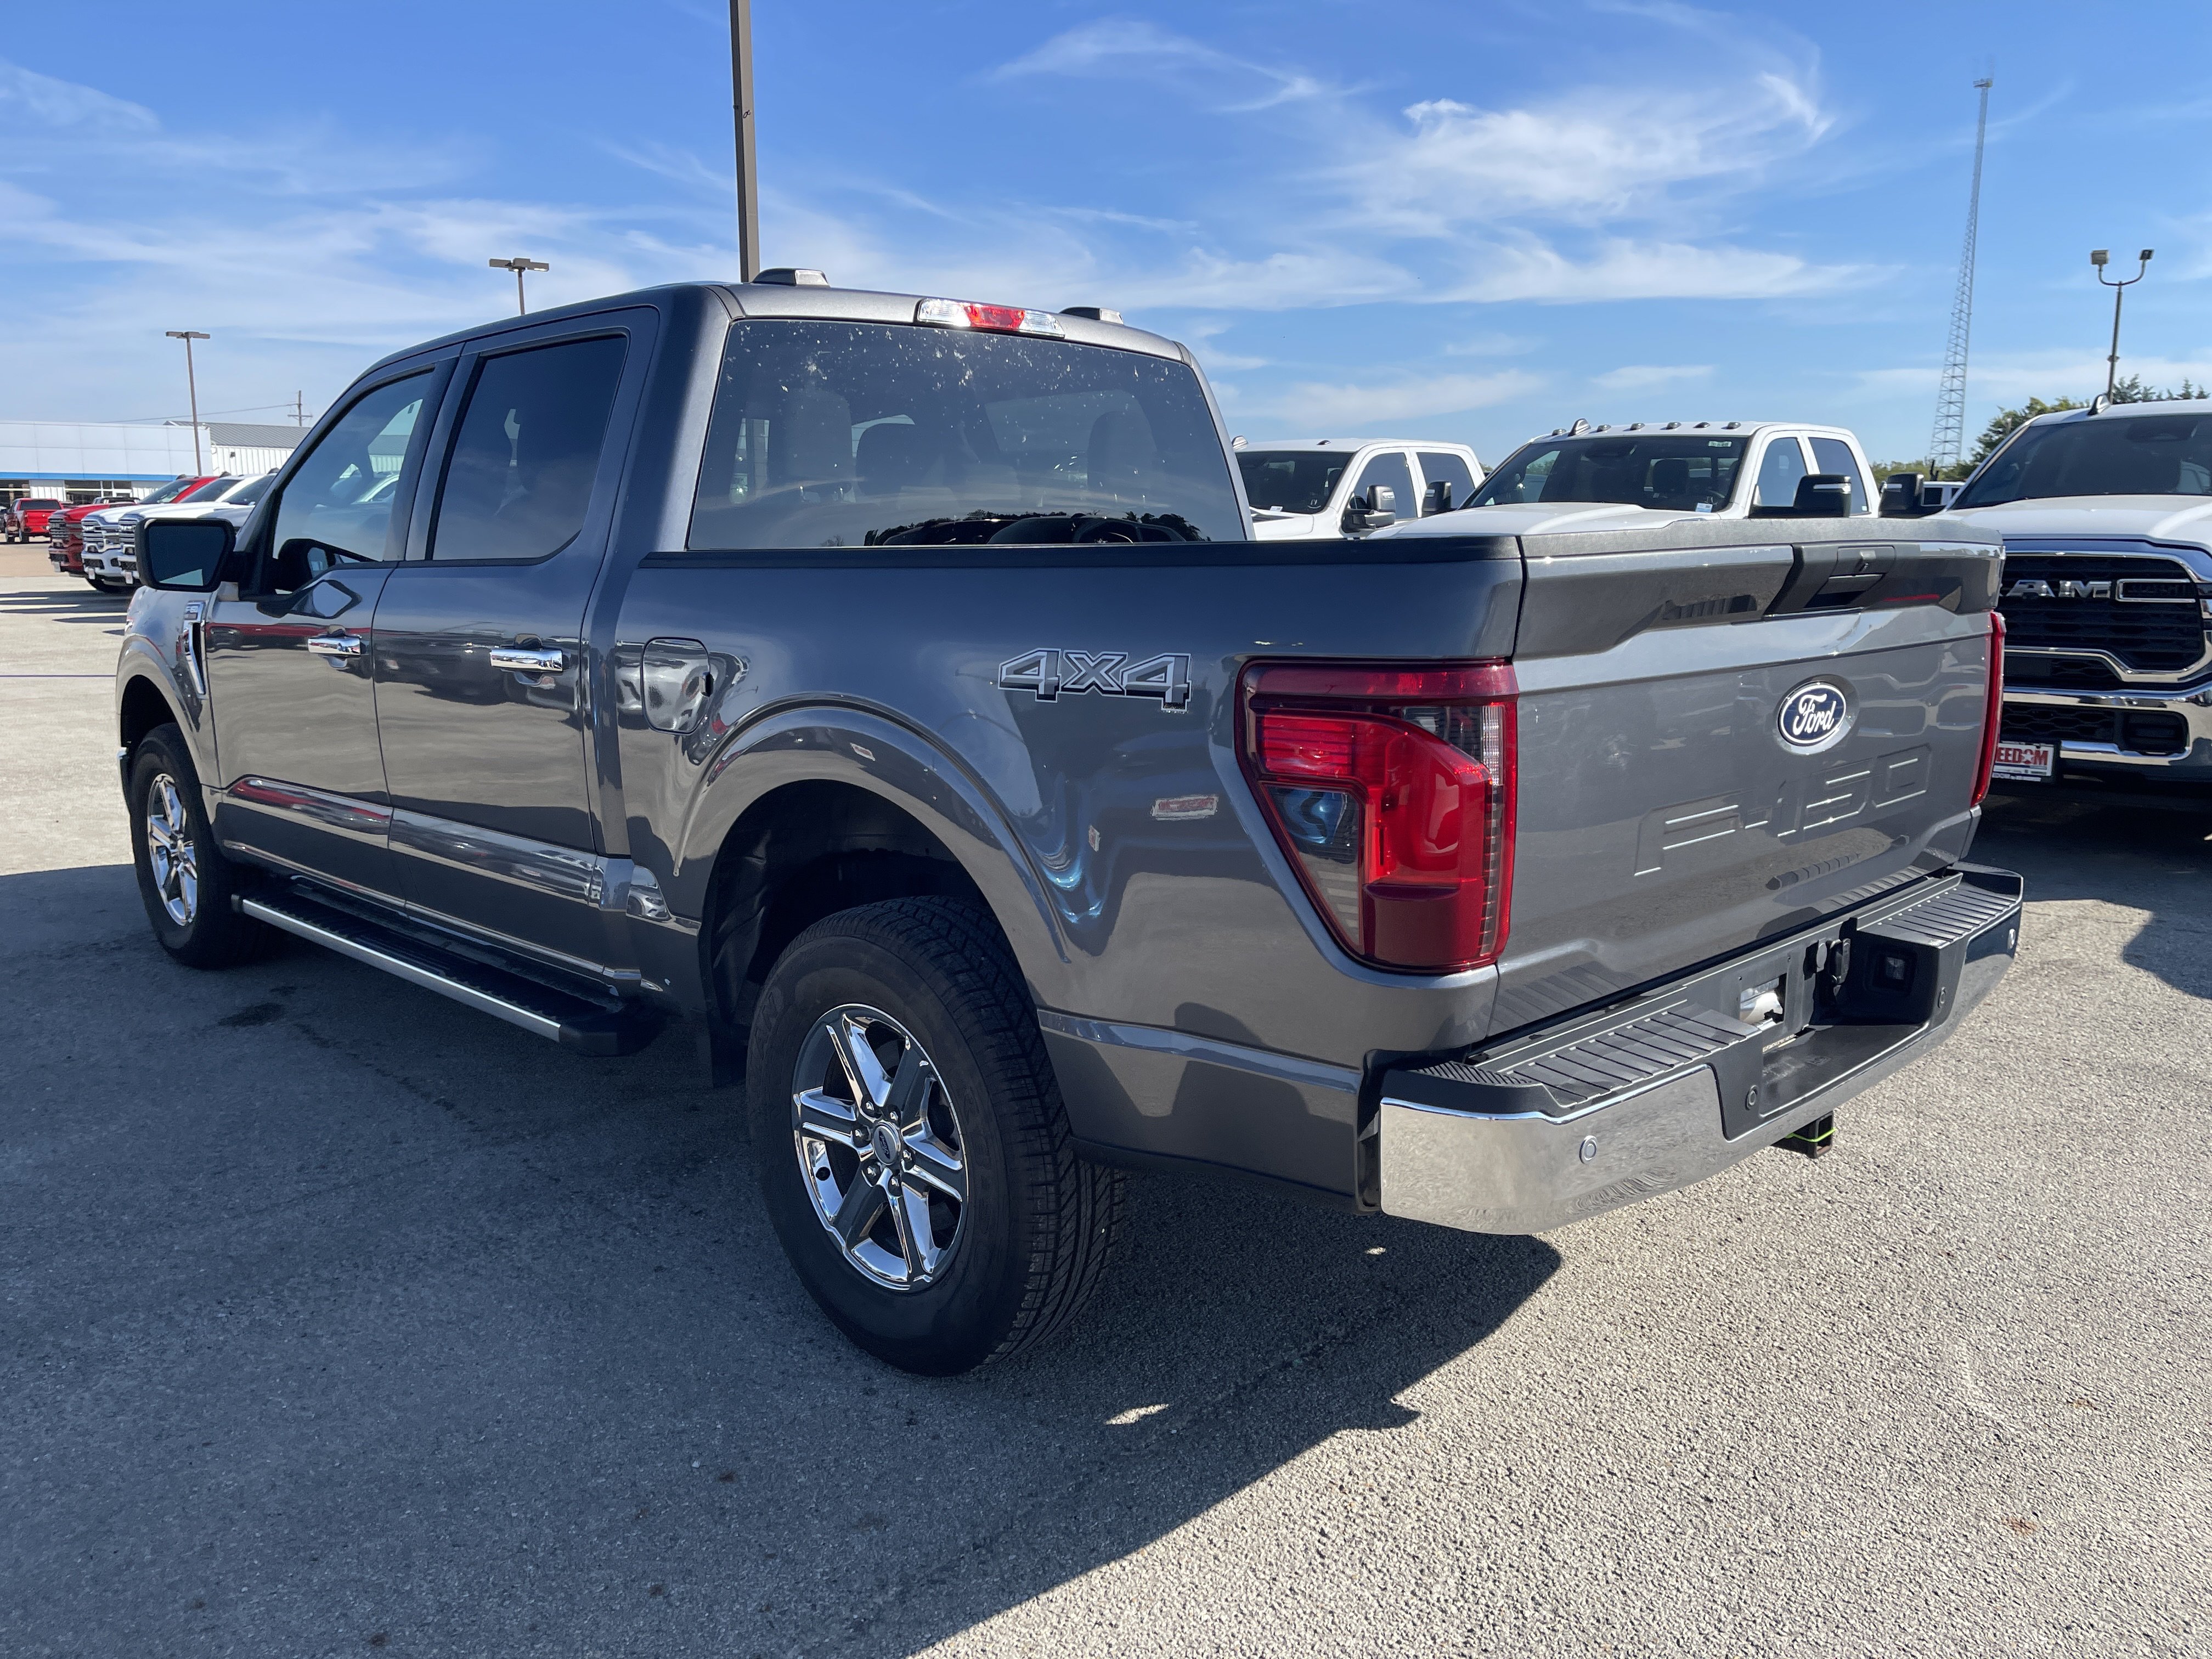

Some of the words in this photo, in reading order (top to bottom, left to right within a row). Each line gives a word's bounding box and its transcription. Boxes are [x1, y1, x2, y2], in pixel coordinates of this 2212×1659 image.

[2002, 580, 2112, 598] AM
[1793, 693, 1836, 736] Ford
[1996, 747, 2049, 766] EEDOM
[1634, 742, 1932, 877] F-150
